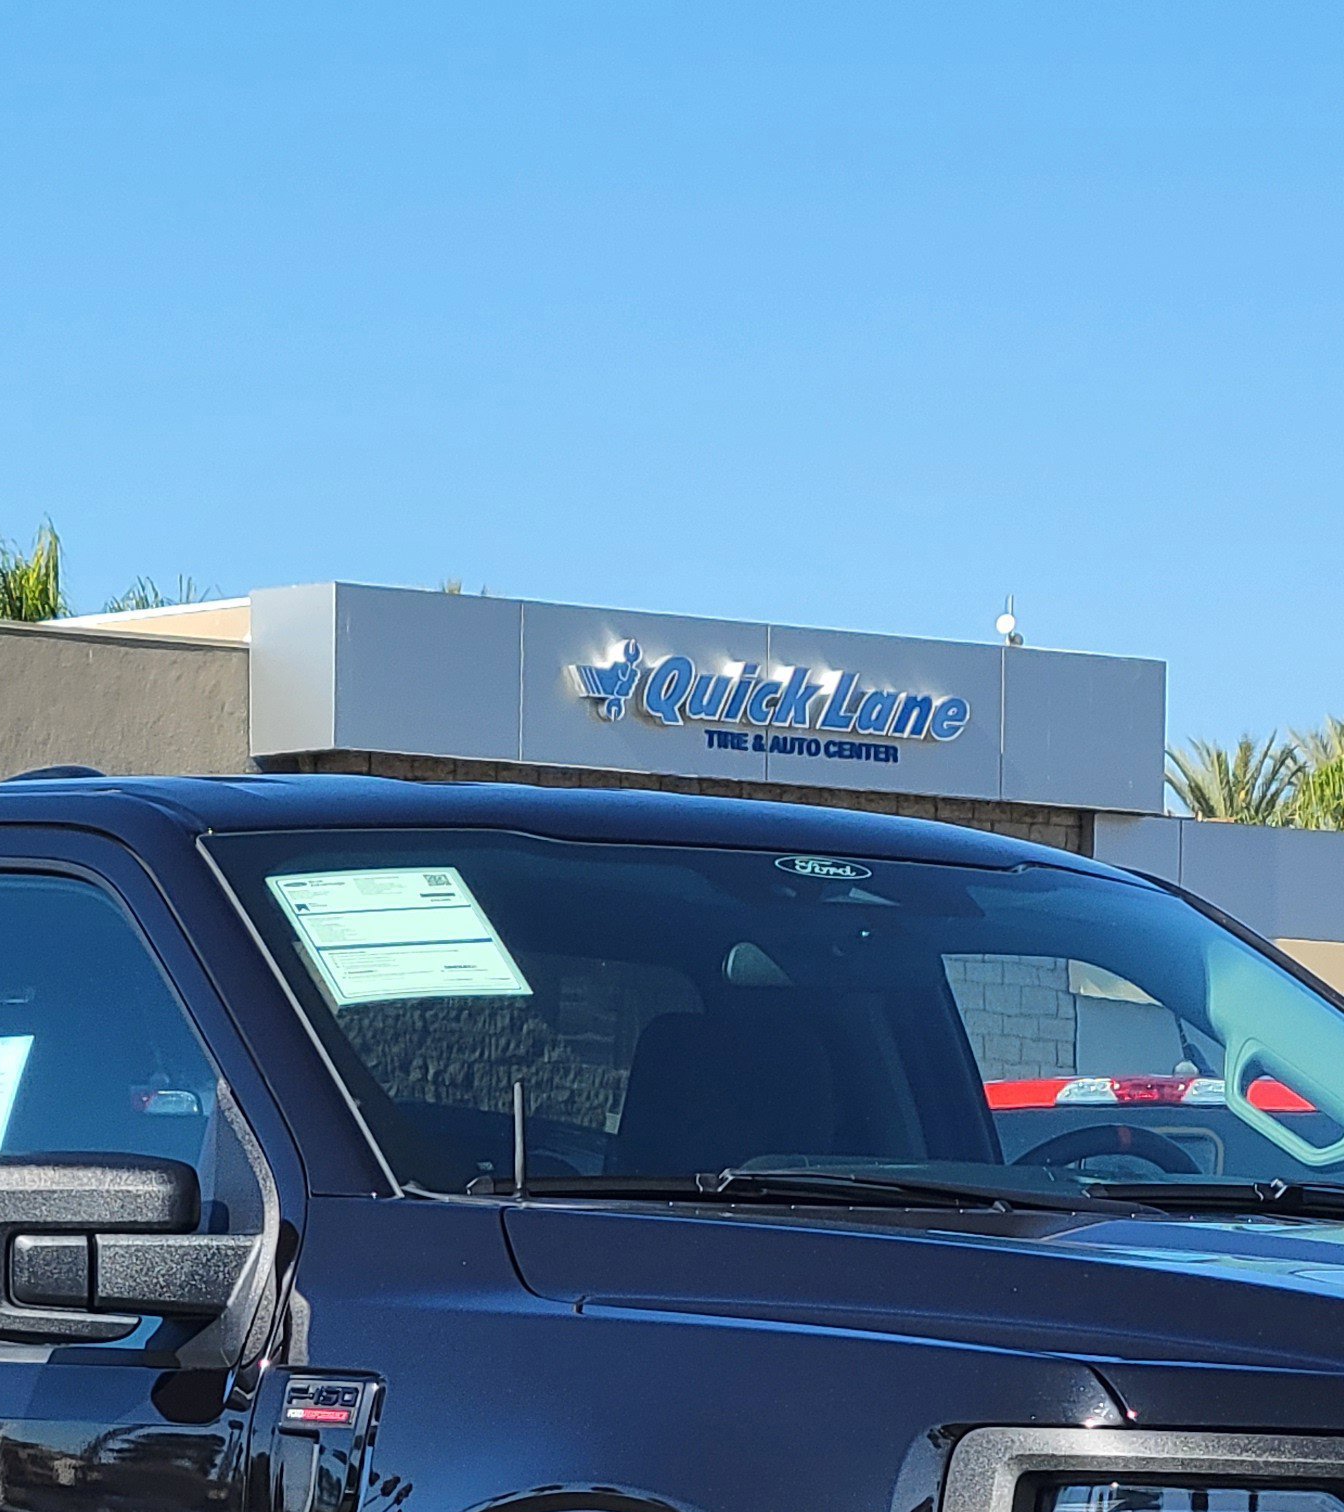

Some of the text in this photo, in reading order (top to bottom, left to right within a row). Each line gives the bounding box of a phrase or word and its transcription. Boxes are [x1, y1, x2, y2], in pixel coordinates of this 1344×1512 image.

[643, 656, 970, 741] Quick Lane
[705, 730, 899, 763] TIRE & AUTO CENTER
[795, 858, 856, 877] Ford
[287, 1385, 359, 1407] F-150
